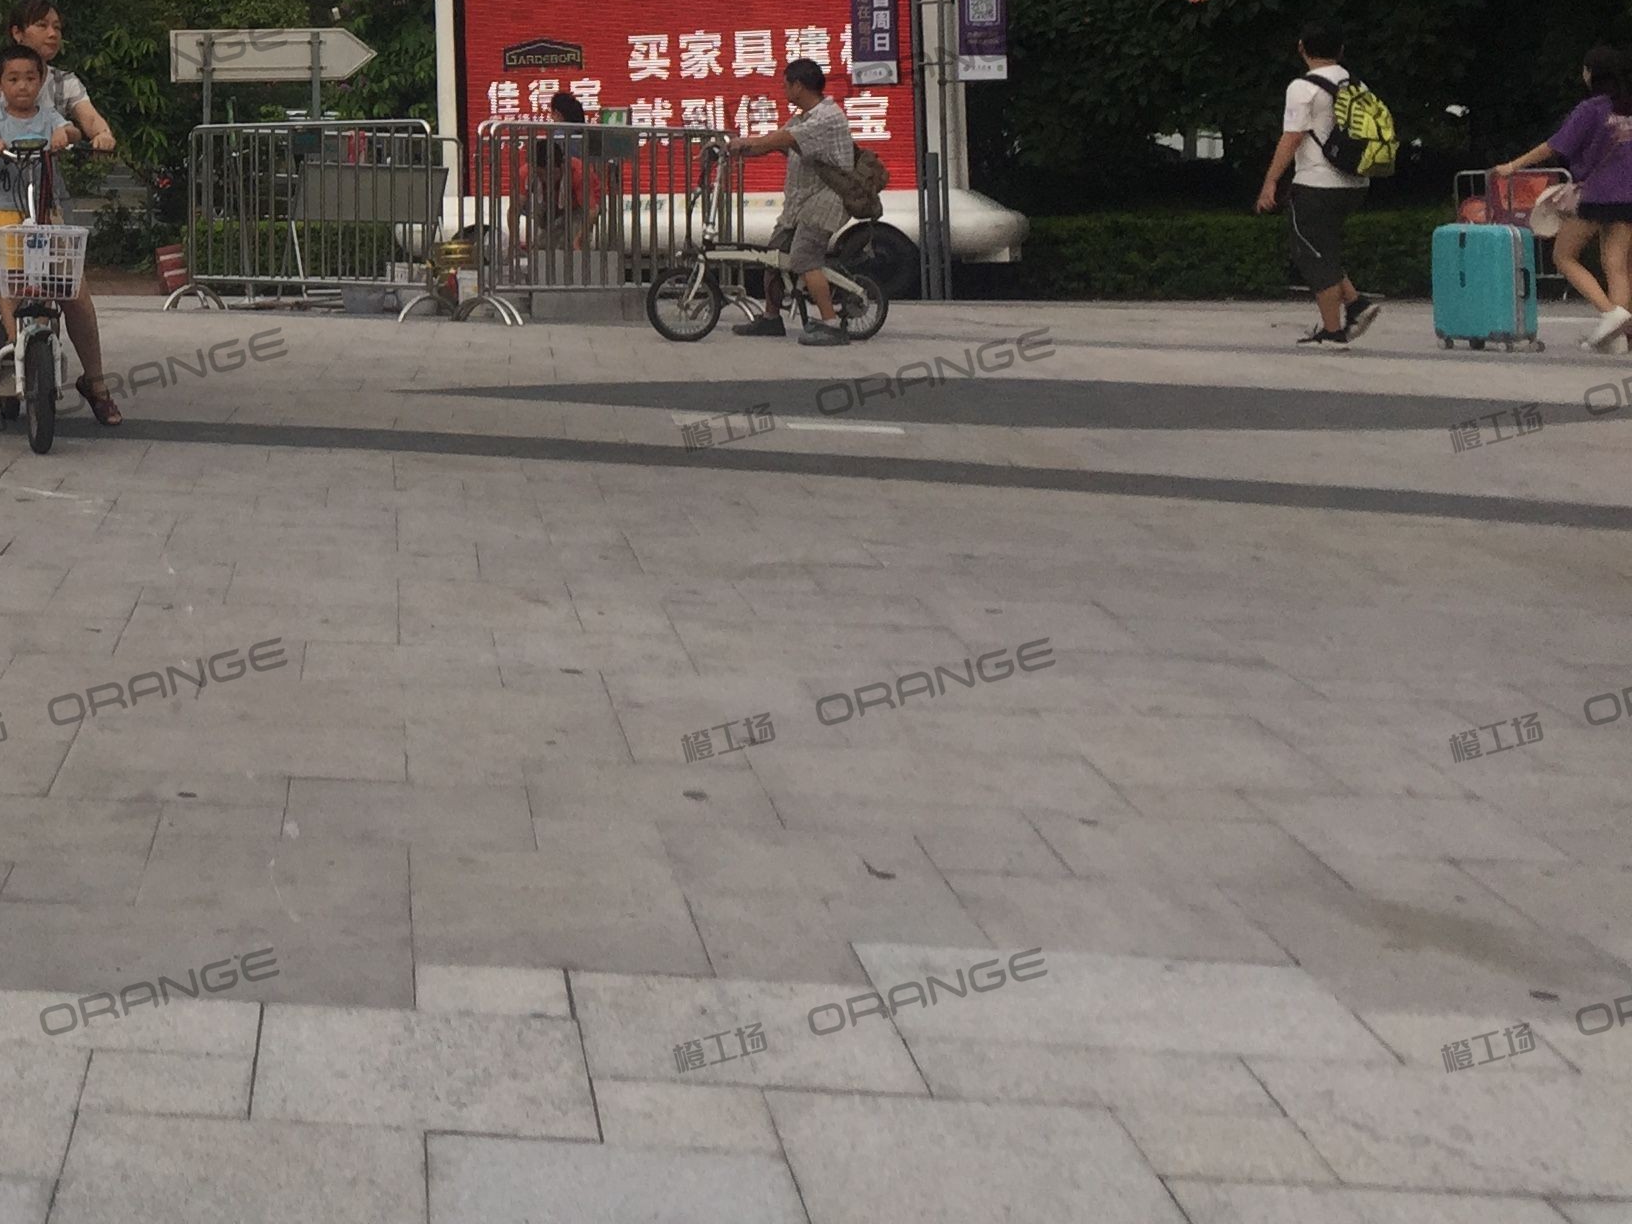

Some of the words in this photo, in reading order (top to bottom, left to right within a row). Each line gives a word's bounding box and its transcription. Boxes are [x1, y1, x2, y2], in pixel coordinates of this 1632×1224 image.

[628, 23, 852, 81] 买家具建
[631, 91, 892, 147] 就到佳宝
